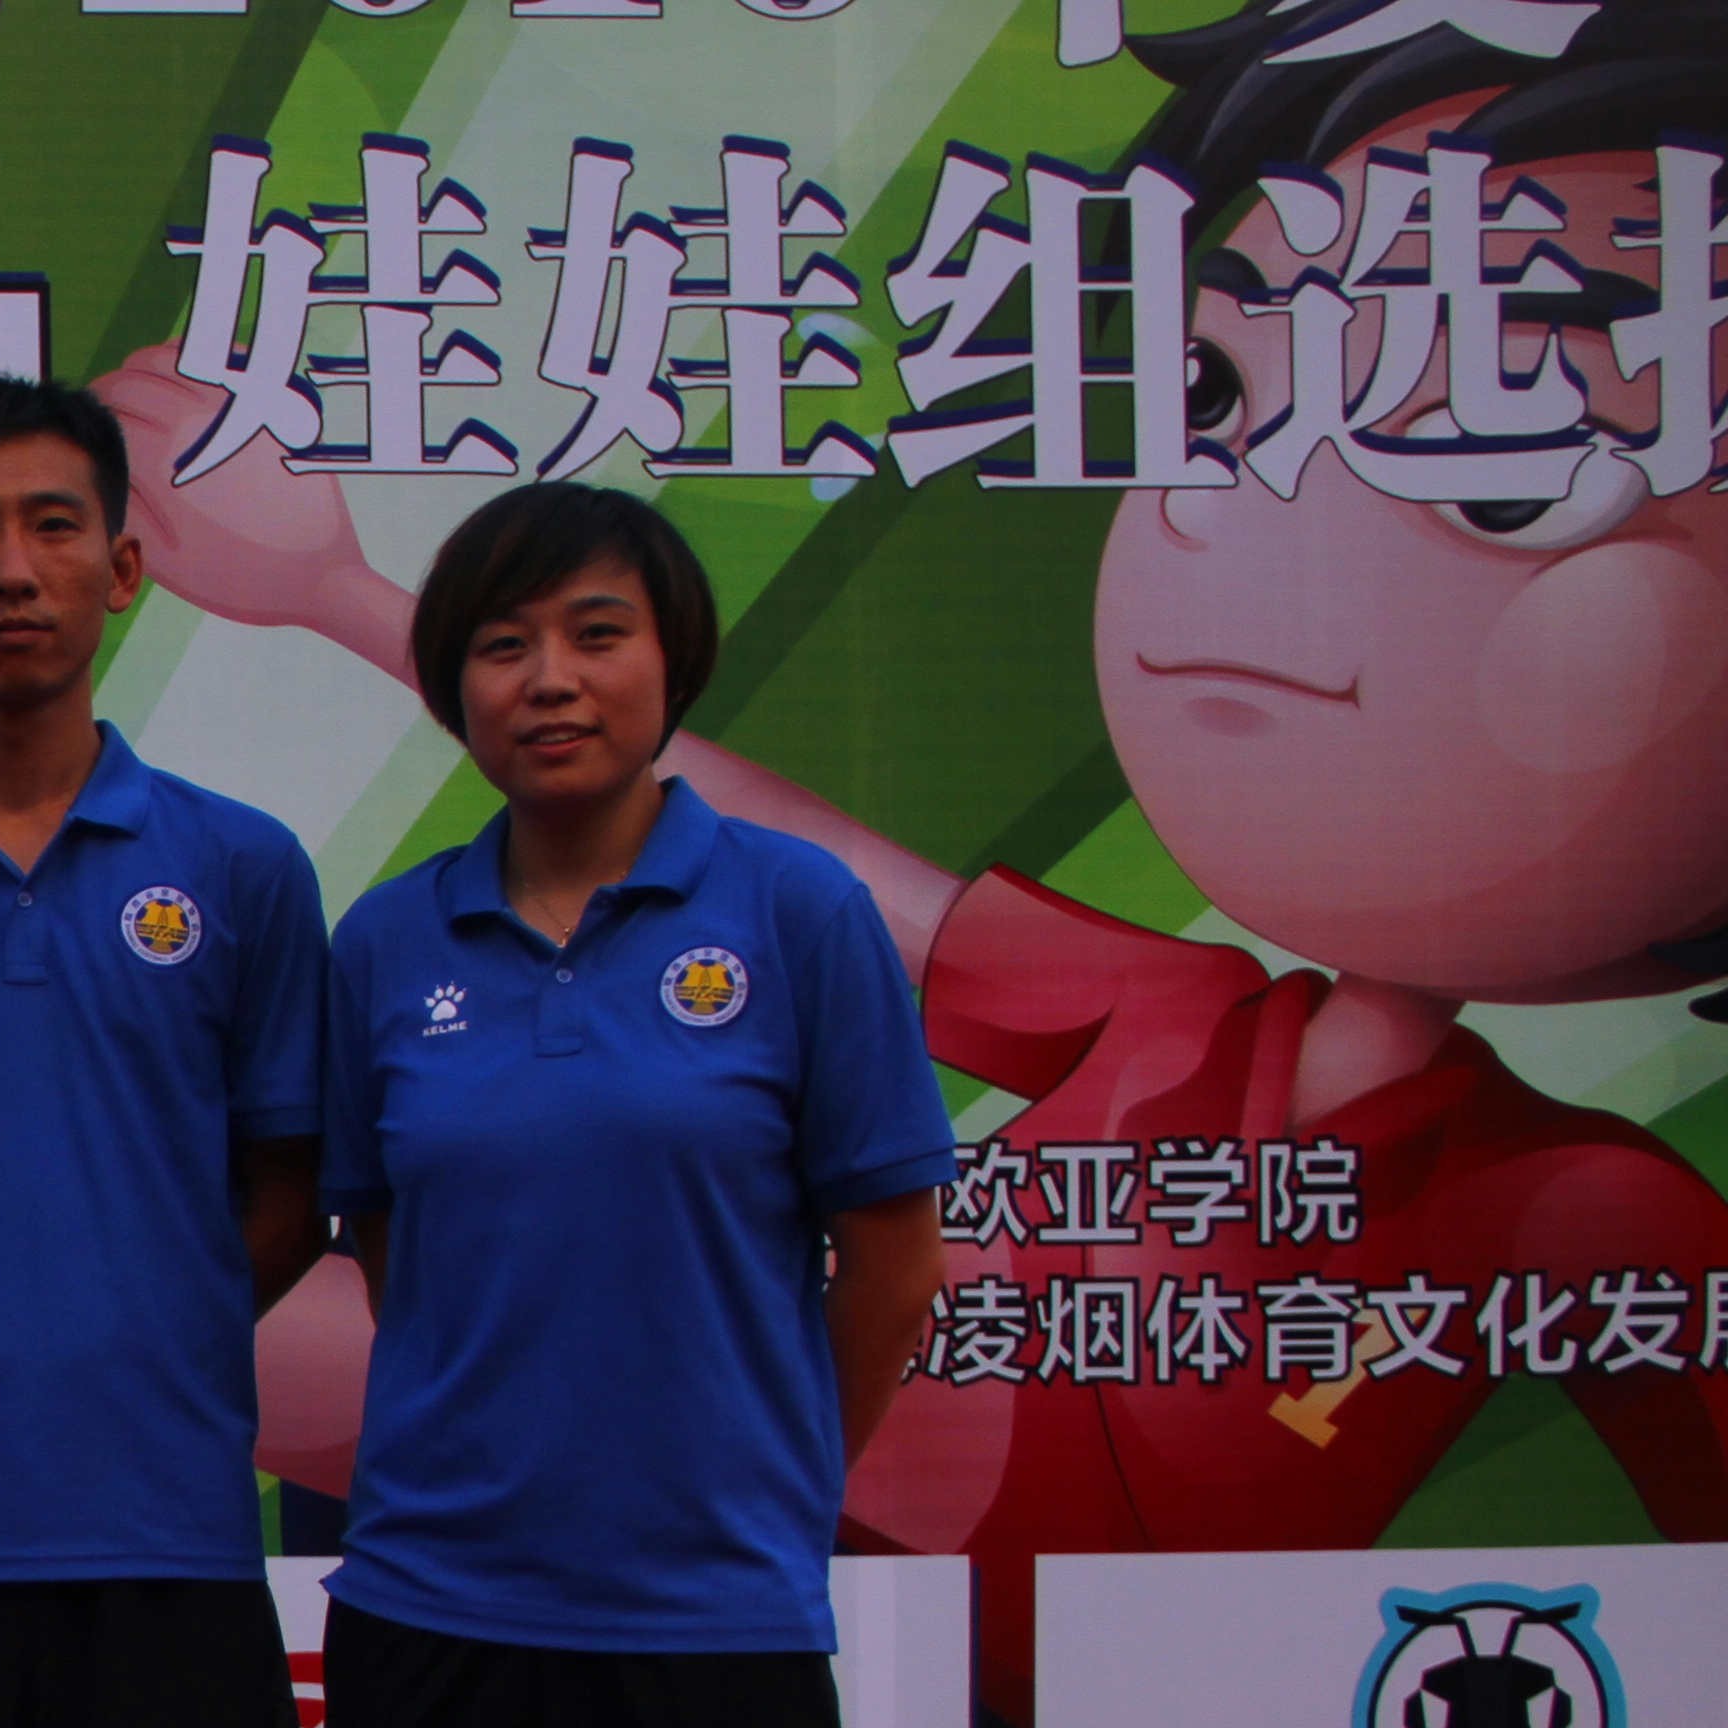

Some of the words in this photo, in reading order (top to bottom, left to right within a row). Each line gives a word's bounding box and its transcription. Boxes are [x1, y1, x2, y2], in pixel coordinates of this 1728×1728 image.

[421, 1020, 469, 1037] KELME
[896, 1268, 1728, 1387] 凌烟体育文化发
